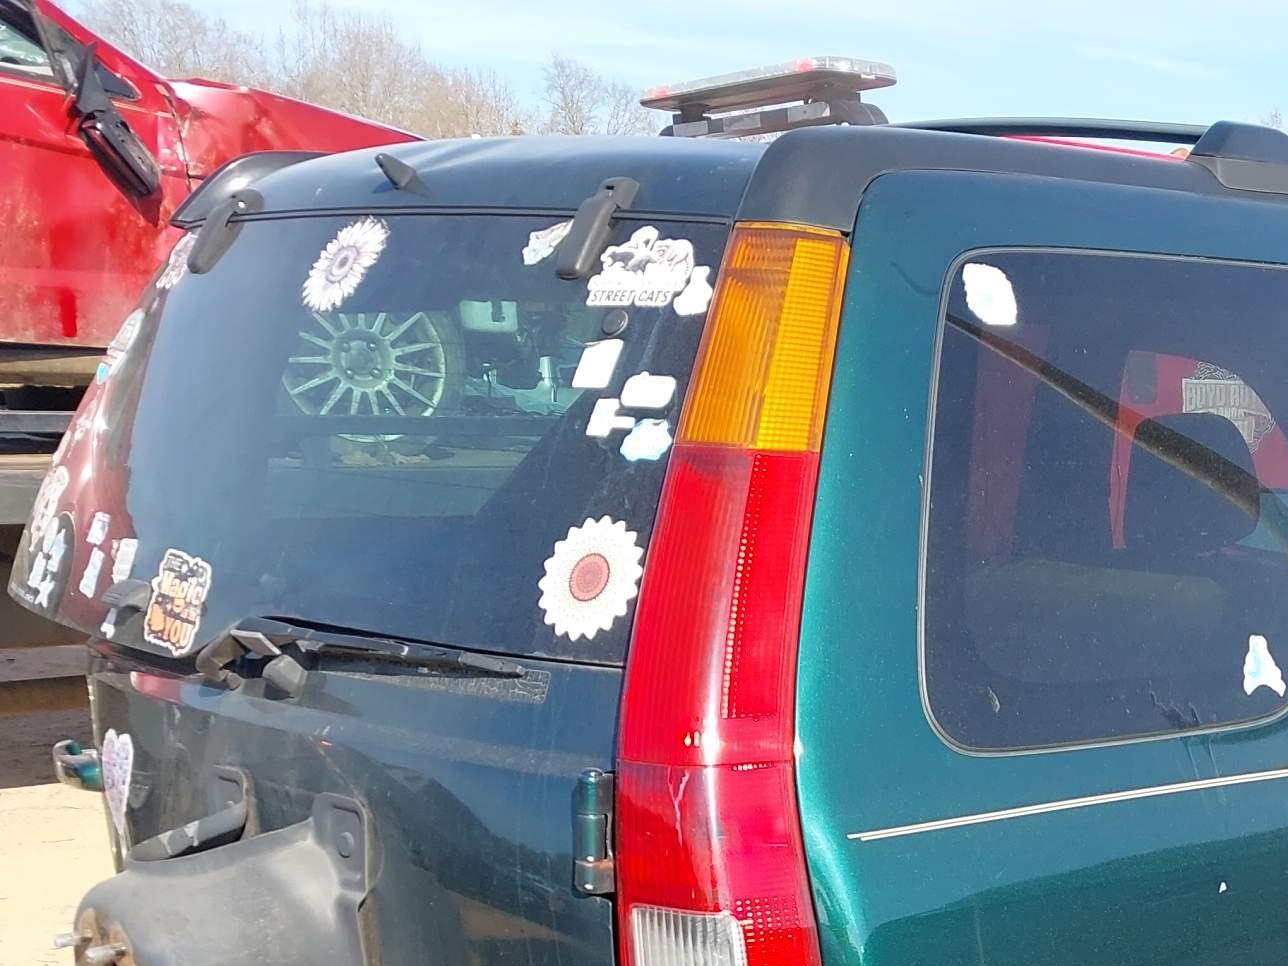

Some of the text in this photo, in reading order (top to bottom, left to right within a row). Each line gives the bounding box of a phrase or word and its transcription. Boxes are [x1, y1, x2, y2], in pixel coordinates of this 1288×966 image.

[591, 289, 669, 303] STREET CATS
[1186, 383, 1226, 411] BOYD
[163, 616, 195, 647] YOU
